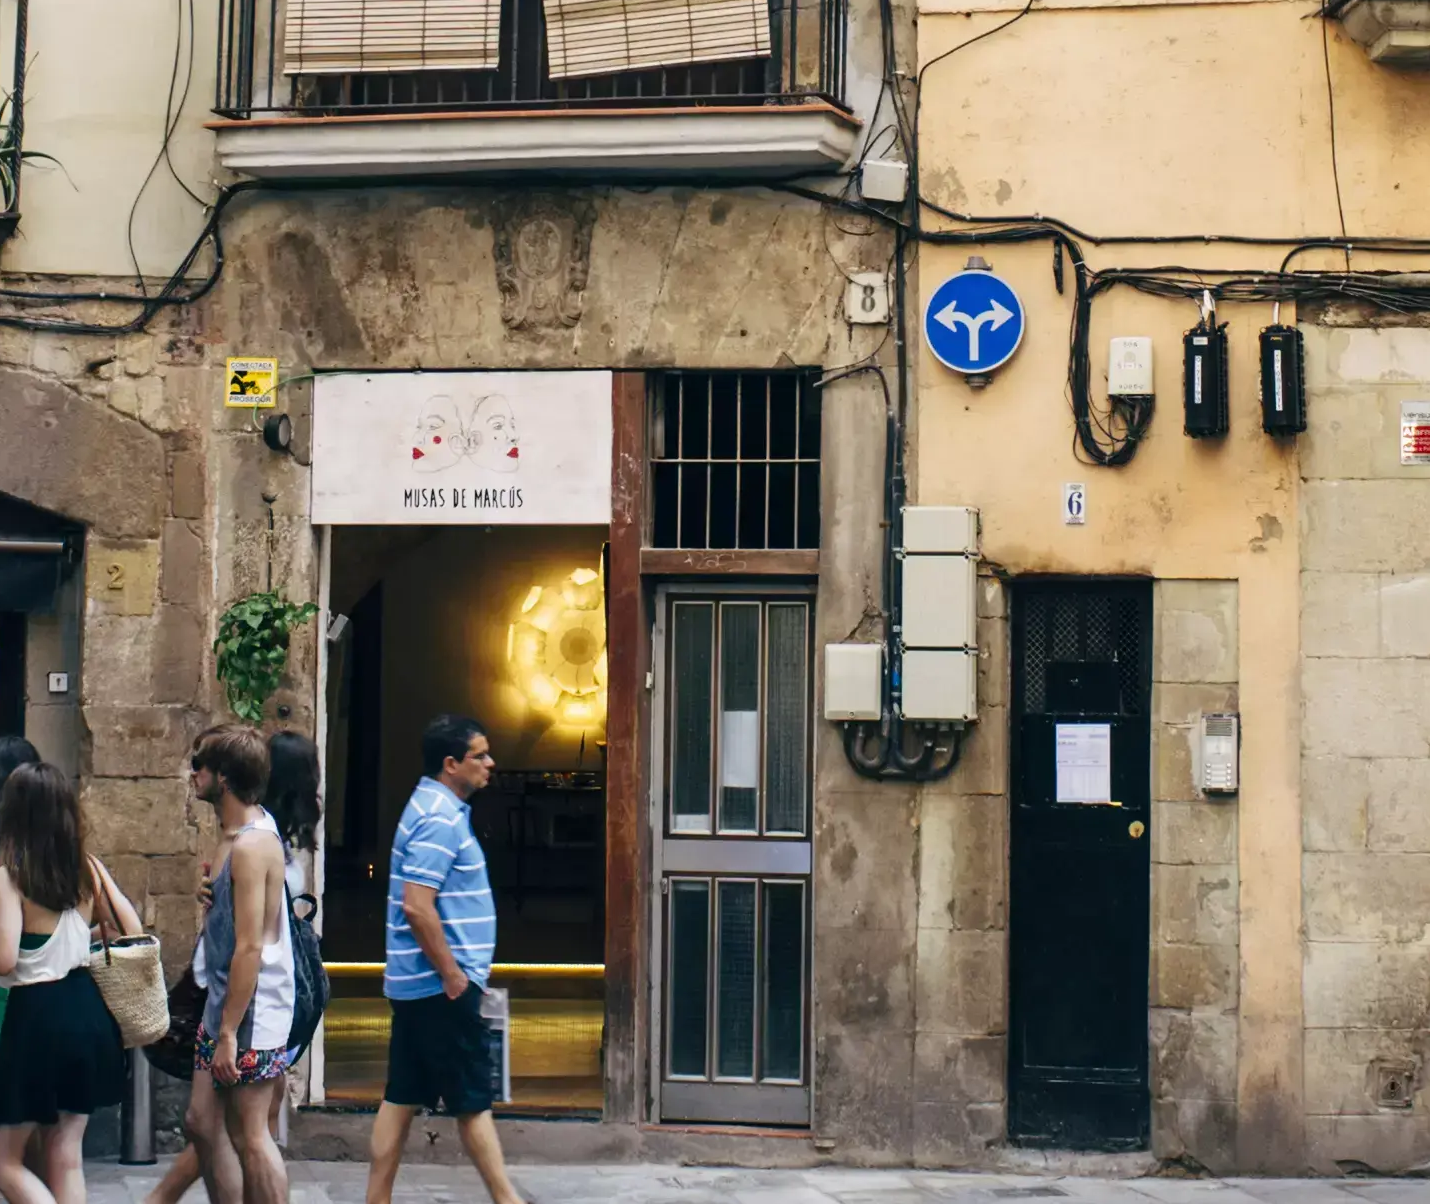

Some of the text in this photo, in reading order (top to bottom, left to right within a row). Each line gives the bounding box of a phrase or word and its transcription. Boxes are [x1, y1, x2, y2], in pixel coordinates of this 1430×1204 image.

[861, 284, 876, 313] 8
[404, 488, 445, 508] MUSAS
[453, 488, 467, 508] DE
[1068, 491, 1082, 516] 6
[107, 563, 125, 590] 2
